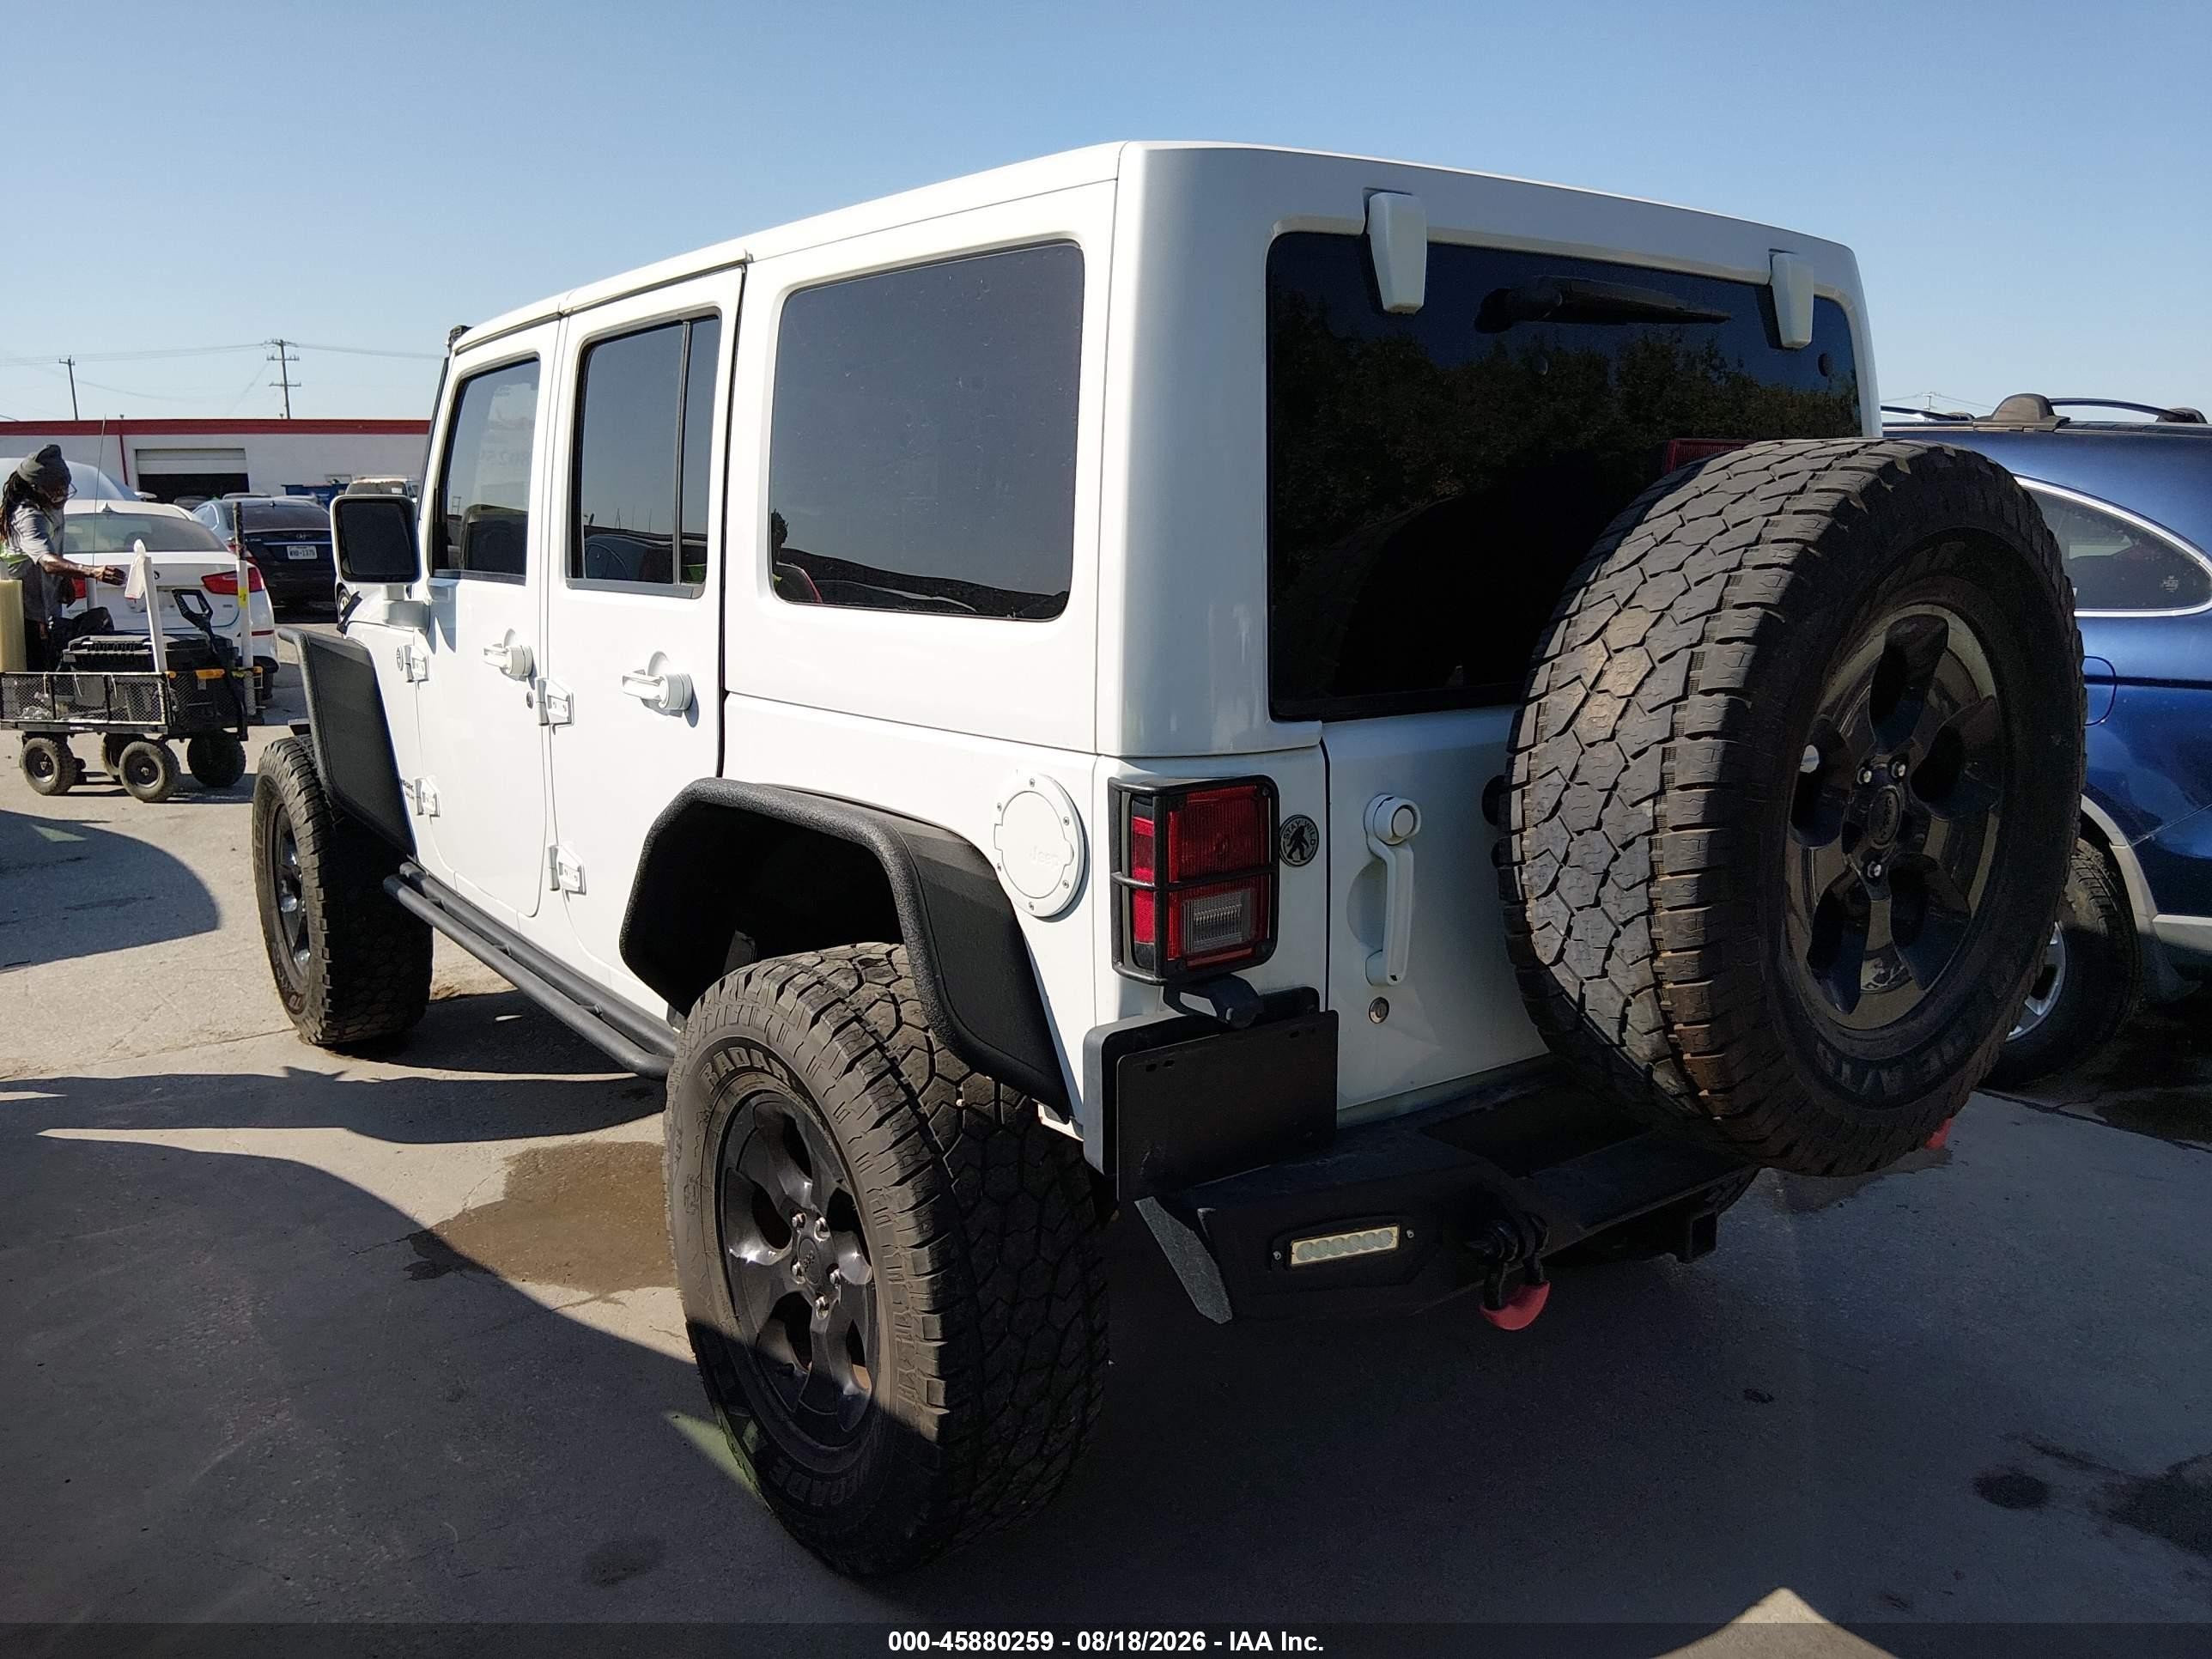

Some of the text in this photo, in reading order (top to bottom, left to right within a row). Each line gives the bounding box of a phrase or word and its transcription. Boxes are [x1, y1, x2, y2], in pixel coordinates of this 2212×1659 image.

[1284, 819, 1317, 846] STAY WILD
[1030, 845, 1060, 871] Jeep
[699, 1046, 793, 1095] RADAR
